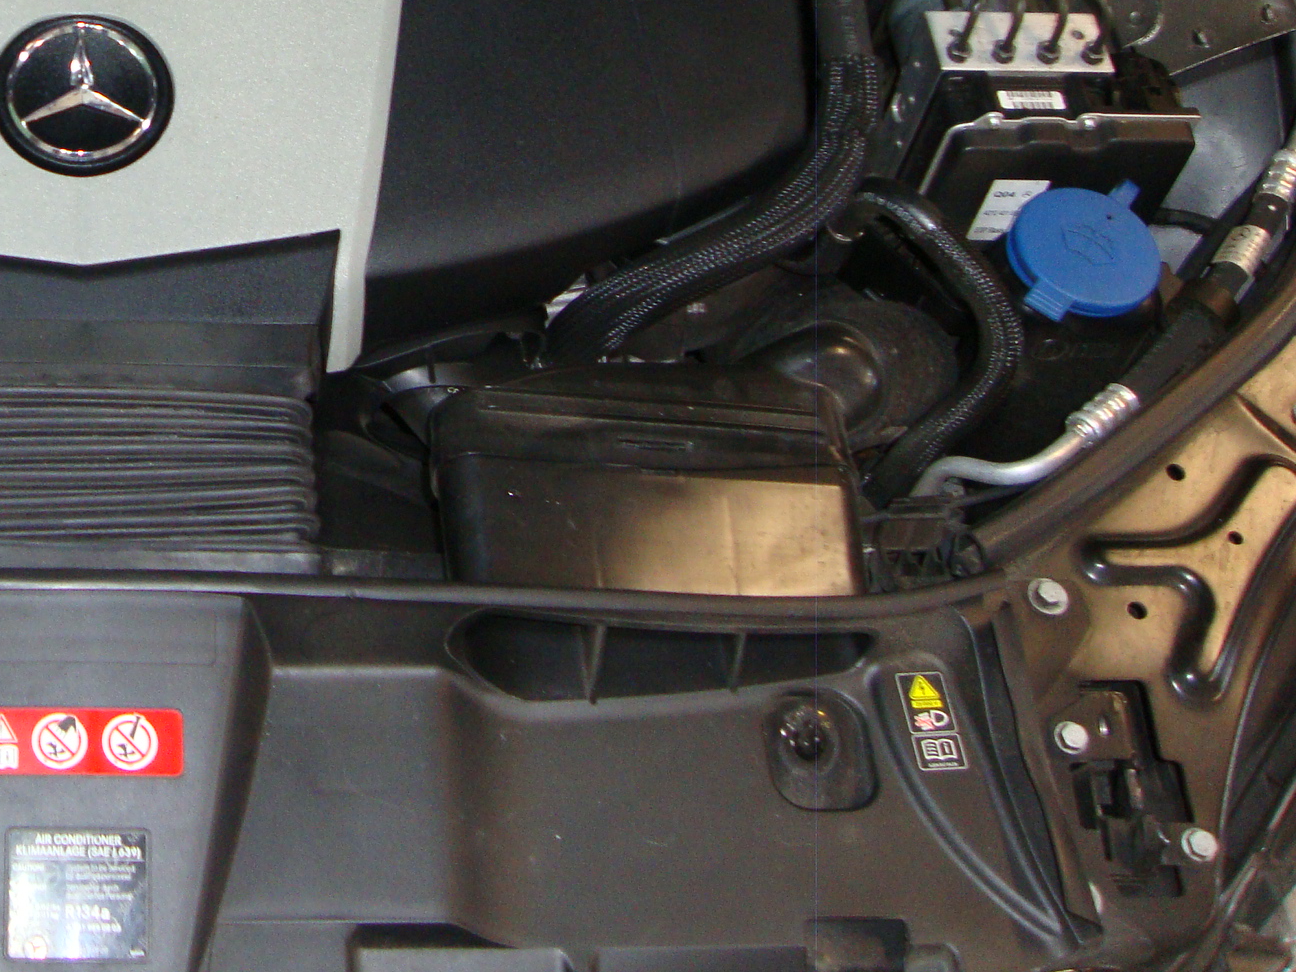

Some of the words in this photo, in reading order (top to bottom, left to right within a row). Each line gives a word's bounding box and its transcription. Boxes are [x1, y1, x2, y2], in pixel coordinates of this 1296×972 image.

[35, 832, 53, 845] AIR
[54, 833, 122, 846] CONDITIONER
[16, 844, 86, 857] KLIMAANLAGE
[65, 903, 111, 920] R134a
